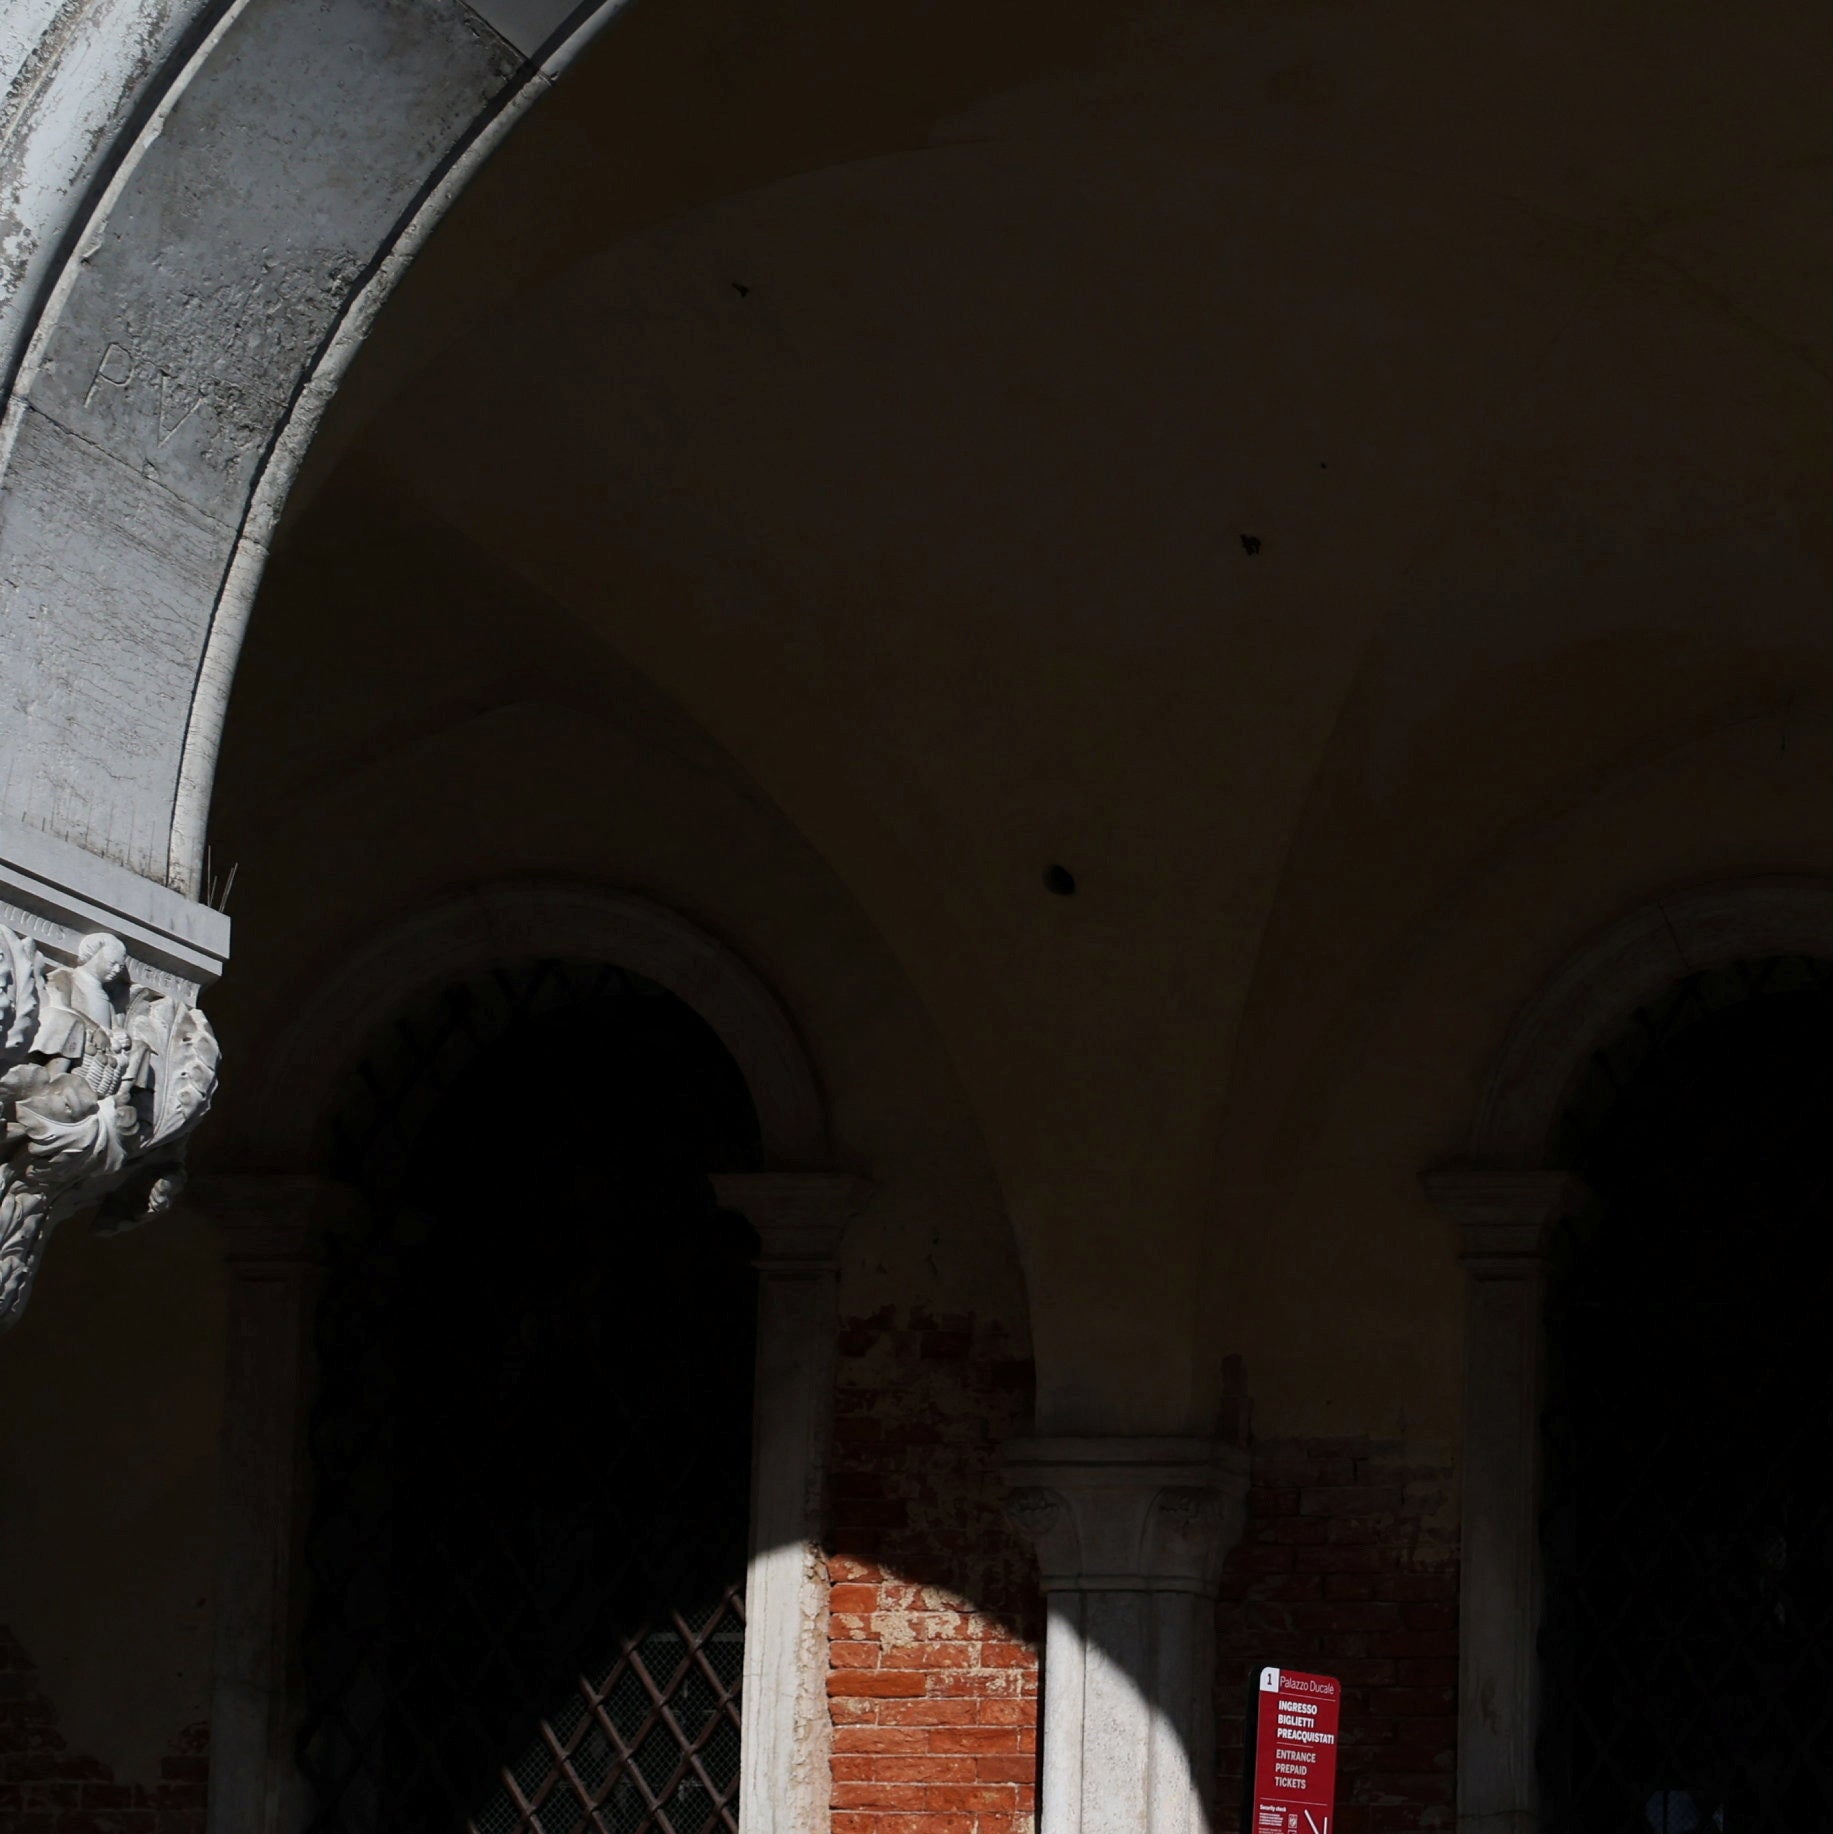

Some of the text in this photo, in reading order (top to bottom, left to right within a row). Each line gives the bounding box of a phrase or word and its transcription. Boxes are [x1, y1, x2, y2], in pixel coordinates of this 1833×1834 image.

[1267, 1673, 1334, 1695] 1 Palazzo Ducale
[1278, 1700, 1318, 1715] INGRESSO
[1278, 1714, 1314, 1728] BIGLIETTI
[1277, 1728, 1334, 1744] PREACQUISTATI
[1276, 1749, 1316, 1763] ENTRANCE
[1275, 1763, 1307, 1776] PREPAID
[1274, 1777, 1306, 1789] TICKETS
